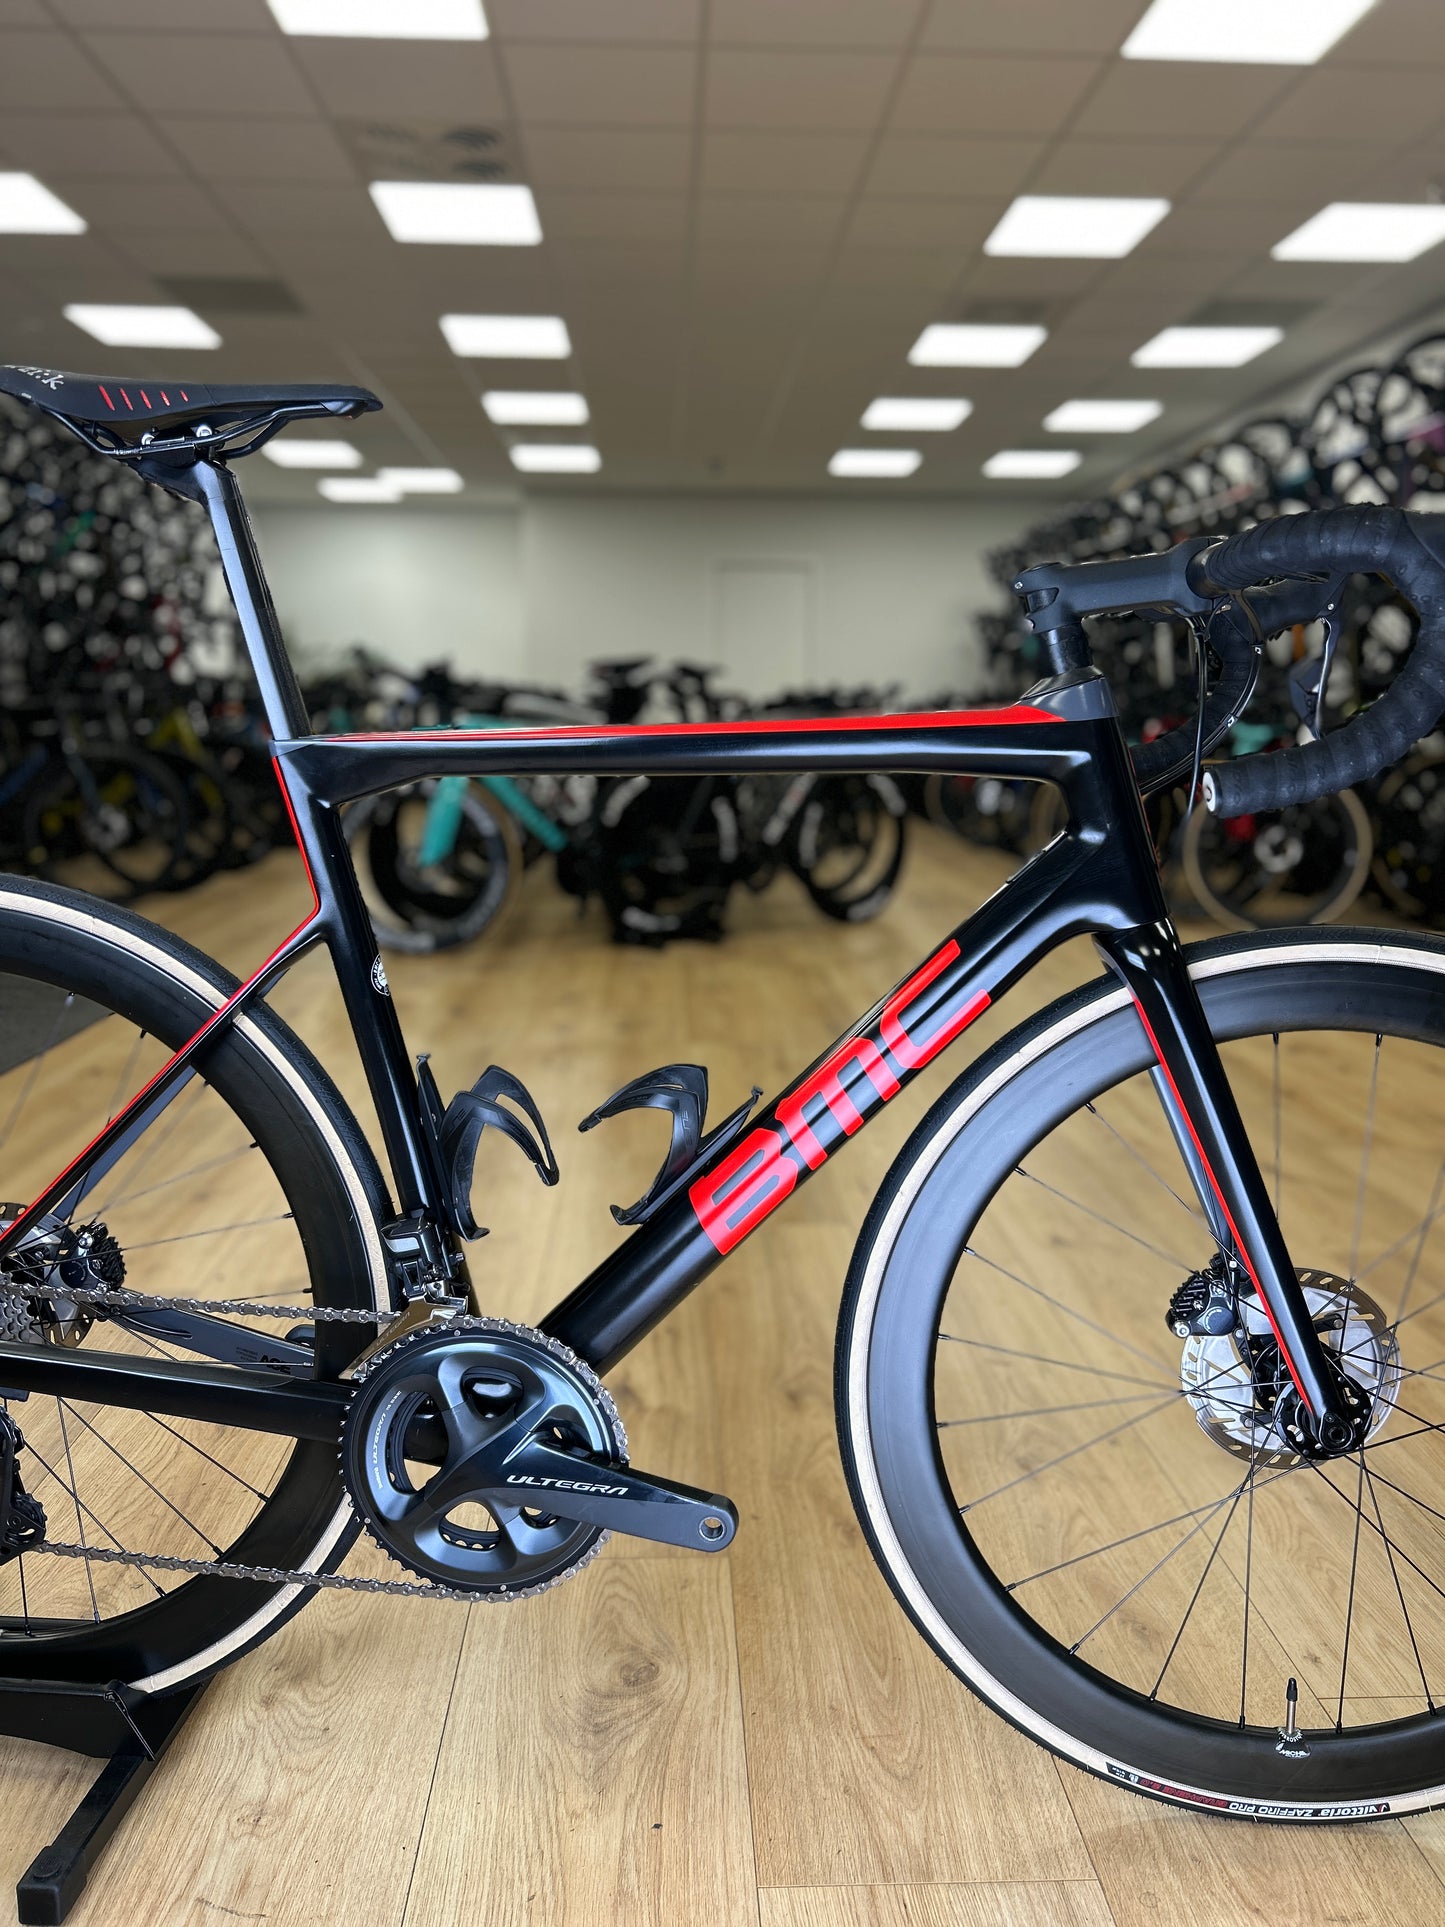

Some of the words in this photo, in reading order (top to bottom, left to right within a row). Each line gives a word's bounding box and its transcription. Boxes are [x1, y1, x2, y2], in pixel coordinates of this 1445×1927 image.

[689, 938, 992, 1256] BMC
[373, 1412, 386, 1464] ULTEGRA
[506, 1474, 629, 1496] ULTEGRA
[1228, 1801, 1256, 1813] PRO
[1258, 1805, 1314, 1817] ZAFFIRO
[1319, 1805, 1378, 1817] vittoria
